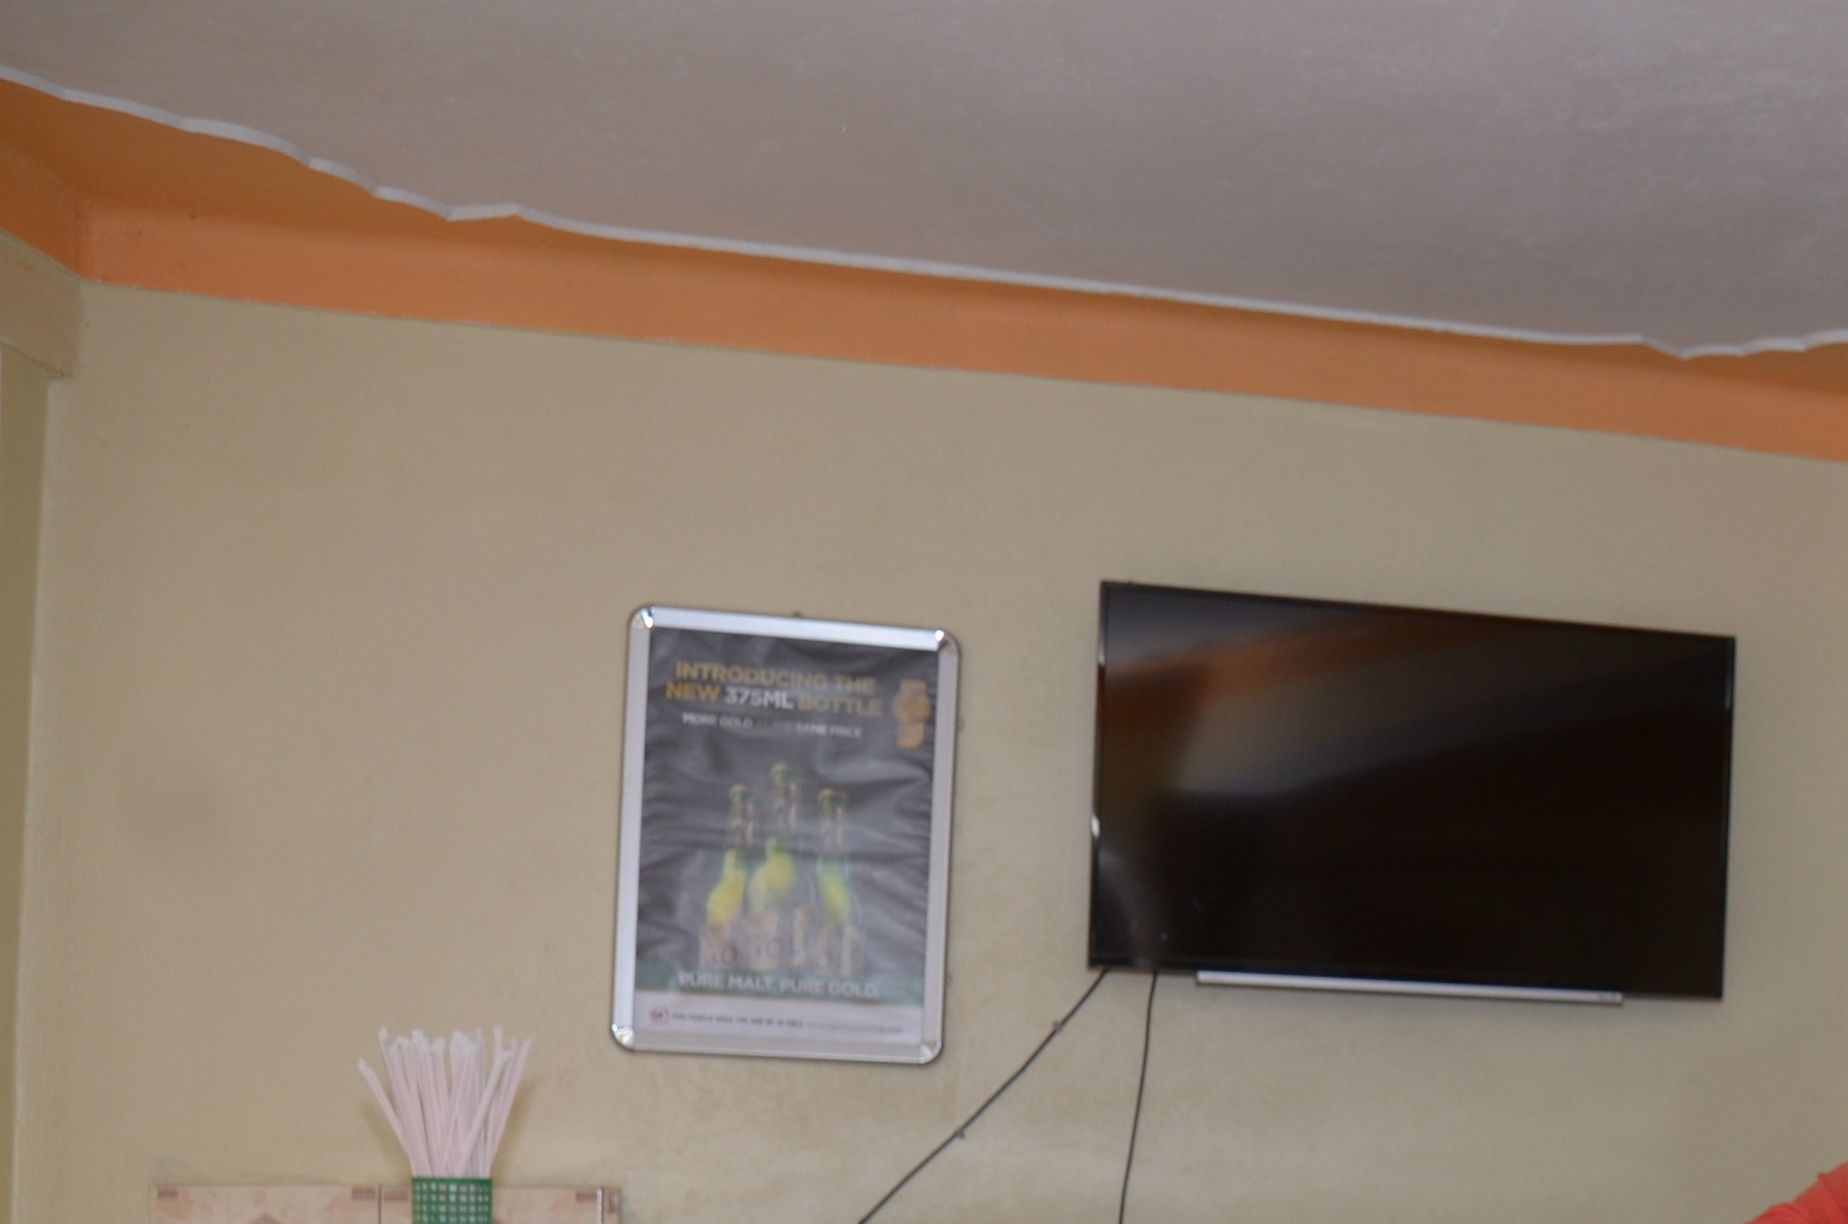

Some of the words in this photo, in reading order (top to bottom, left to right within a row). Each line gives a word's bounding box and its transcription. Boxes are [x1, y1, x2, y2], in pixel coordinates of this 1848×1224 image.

[676, 660, 828, 689] INTRODUCING
[835, 675, 875, 696] THE
[665, 682, 721, 701] NEW
[725, 685, 794, 710] 375ML
[798, 694, 881, 717] BOTTLE
[678, 970, 723, 990] PURE
